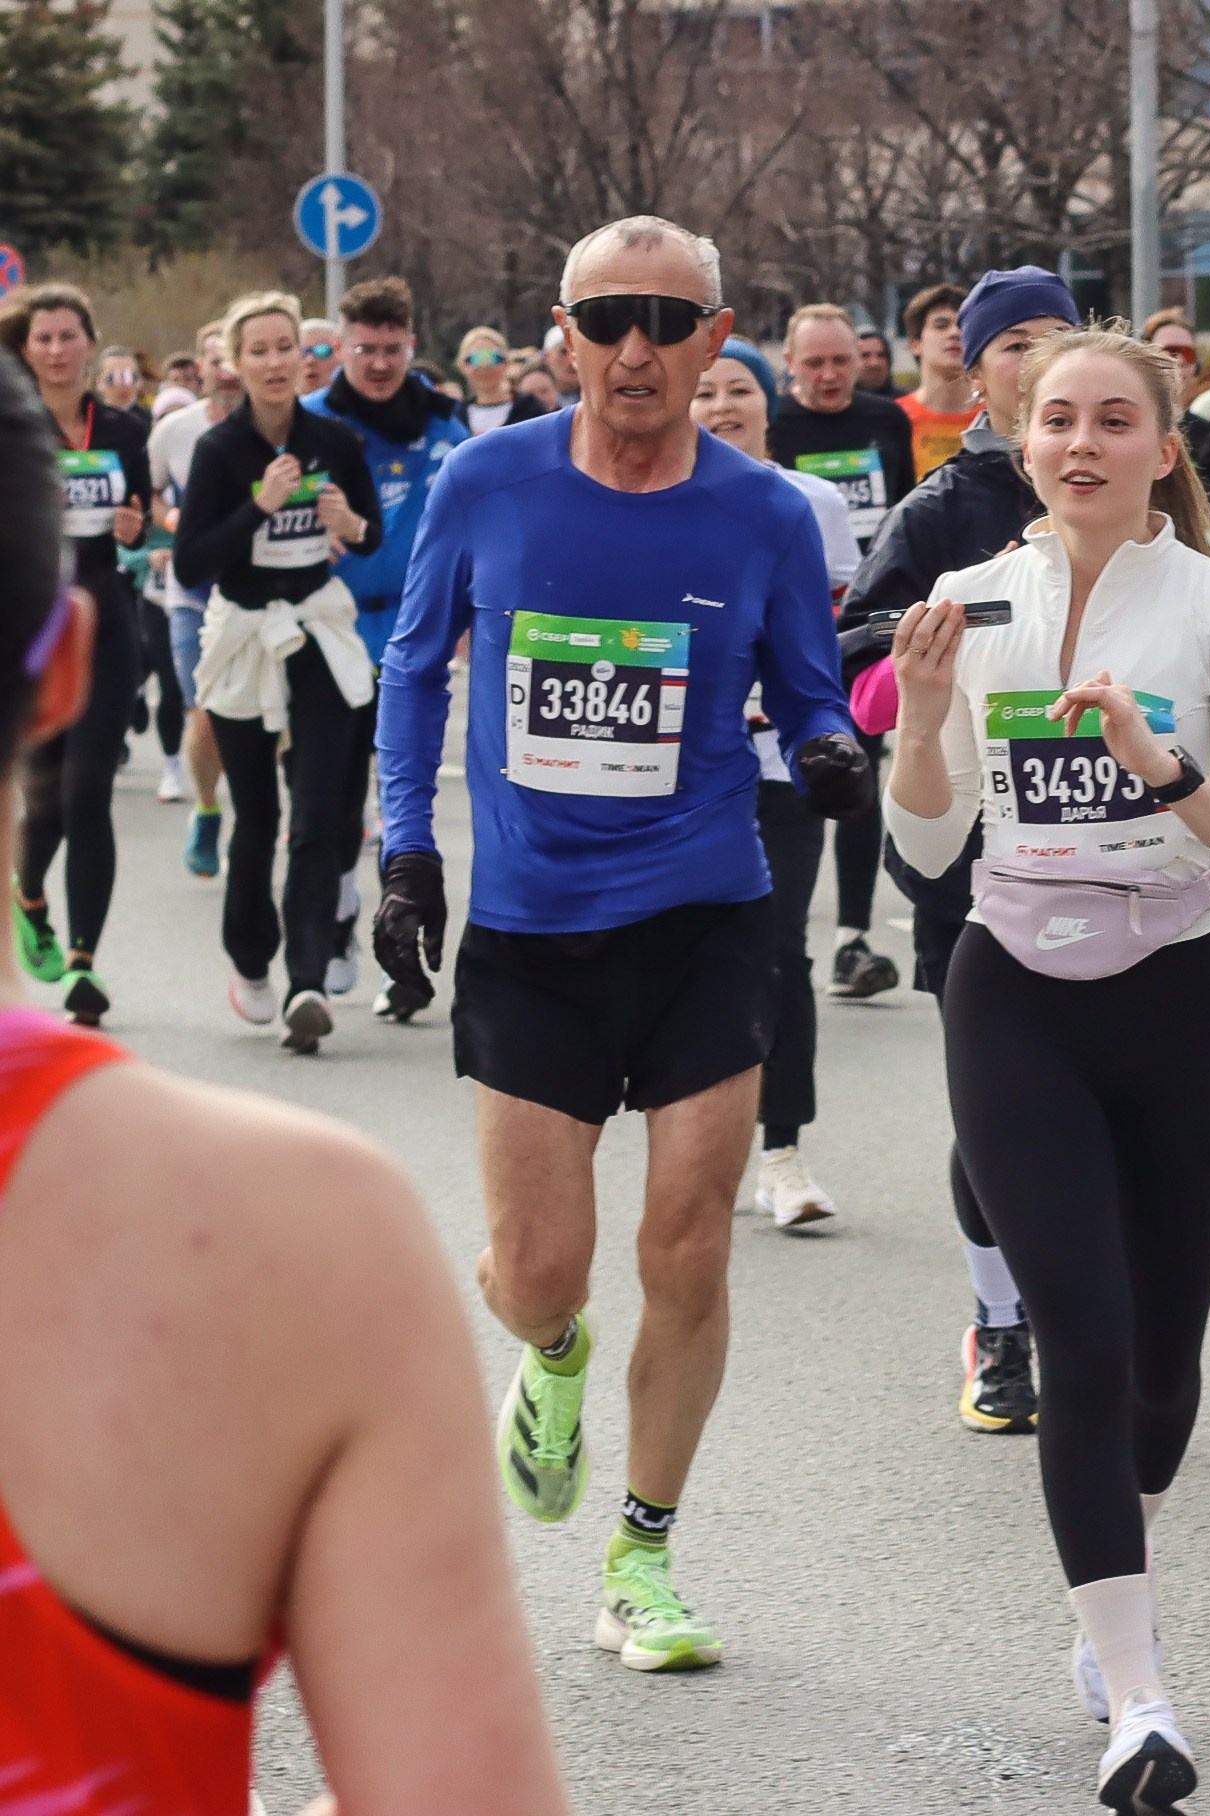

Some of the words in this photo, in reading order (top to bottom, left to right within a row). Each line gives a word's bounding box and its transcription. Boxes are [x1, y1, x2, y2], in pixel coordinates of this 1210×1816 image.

[272, 507, 322, 534] 3727
[510, 683, 526, 706] D
[539, 677, 653, 726] 33846
[992, 770, 1010, 794] B
[1060, 805, 1107, 822] ДАРЬЯ
